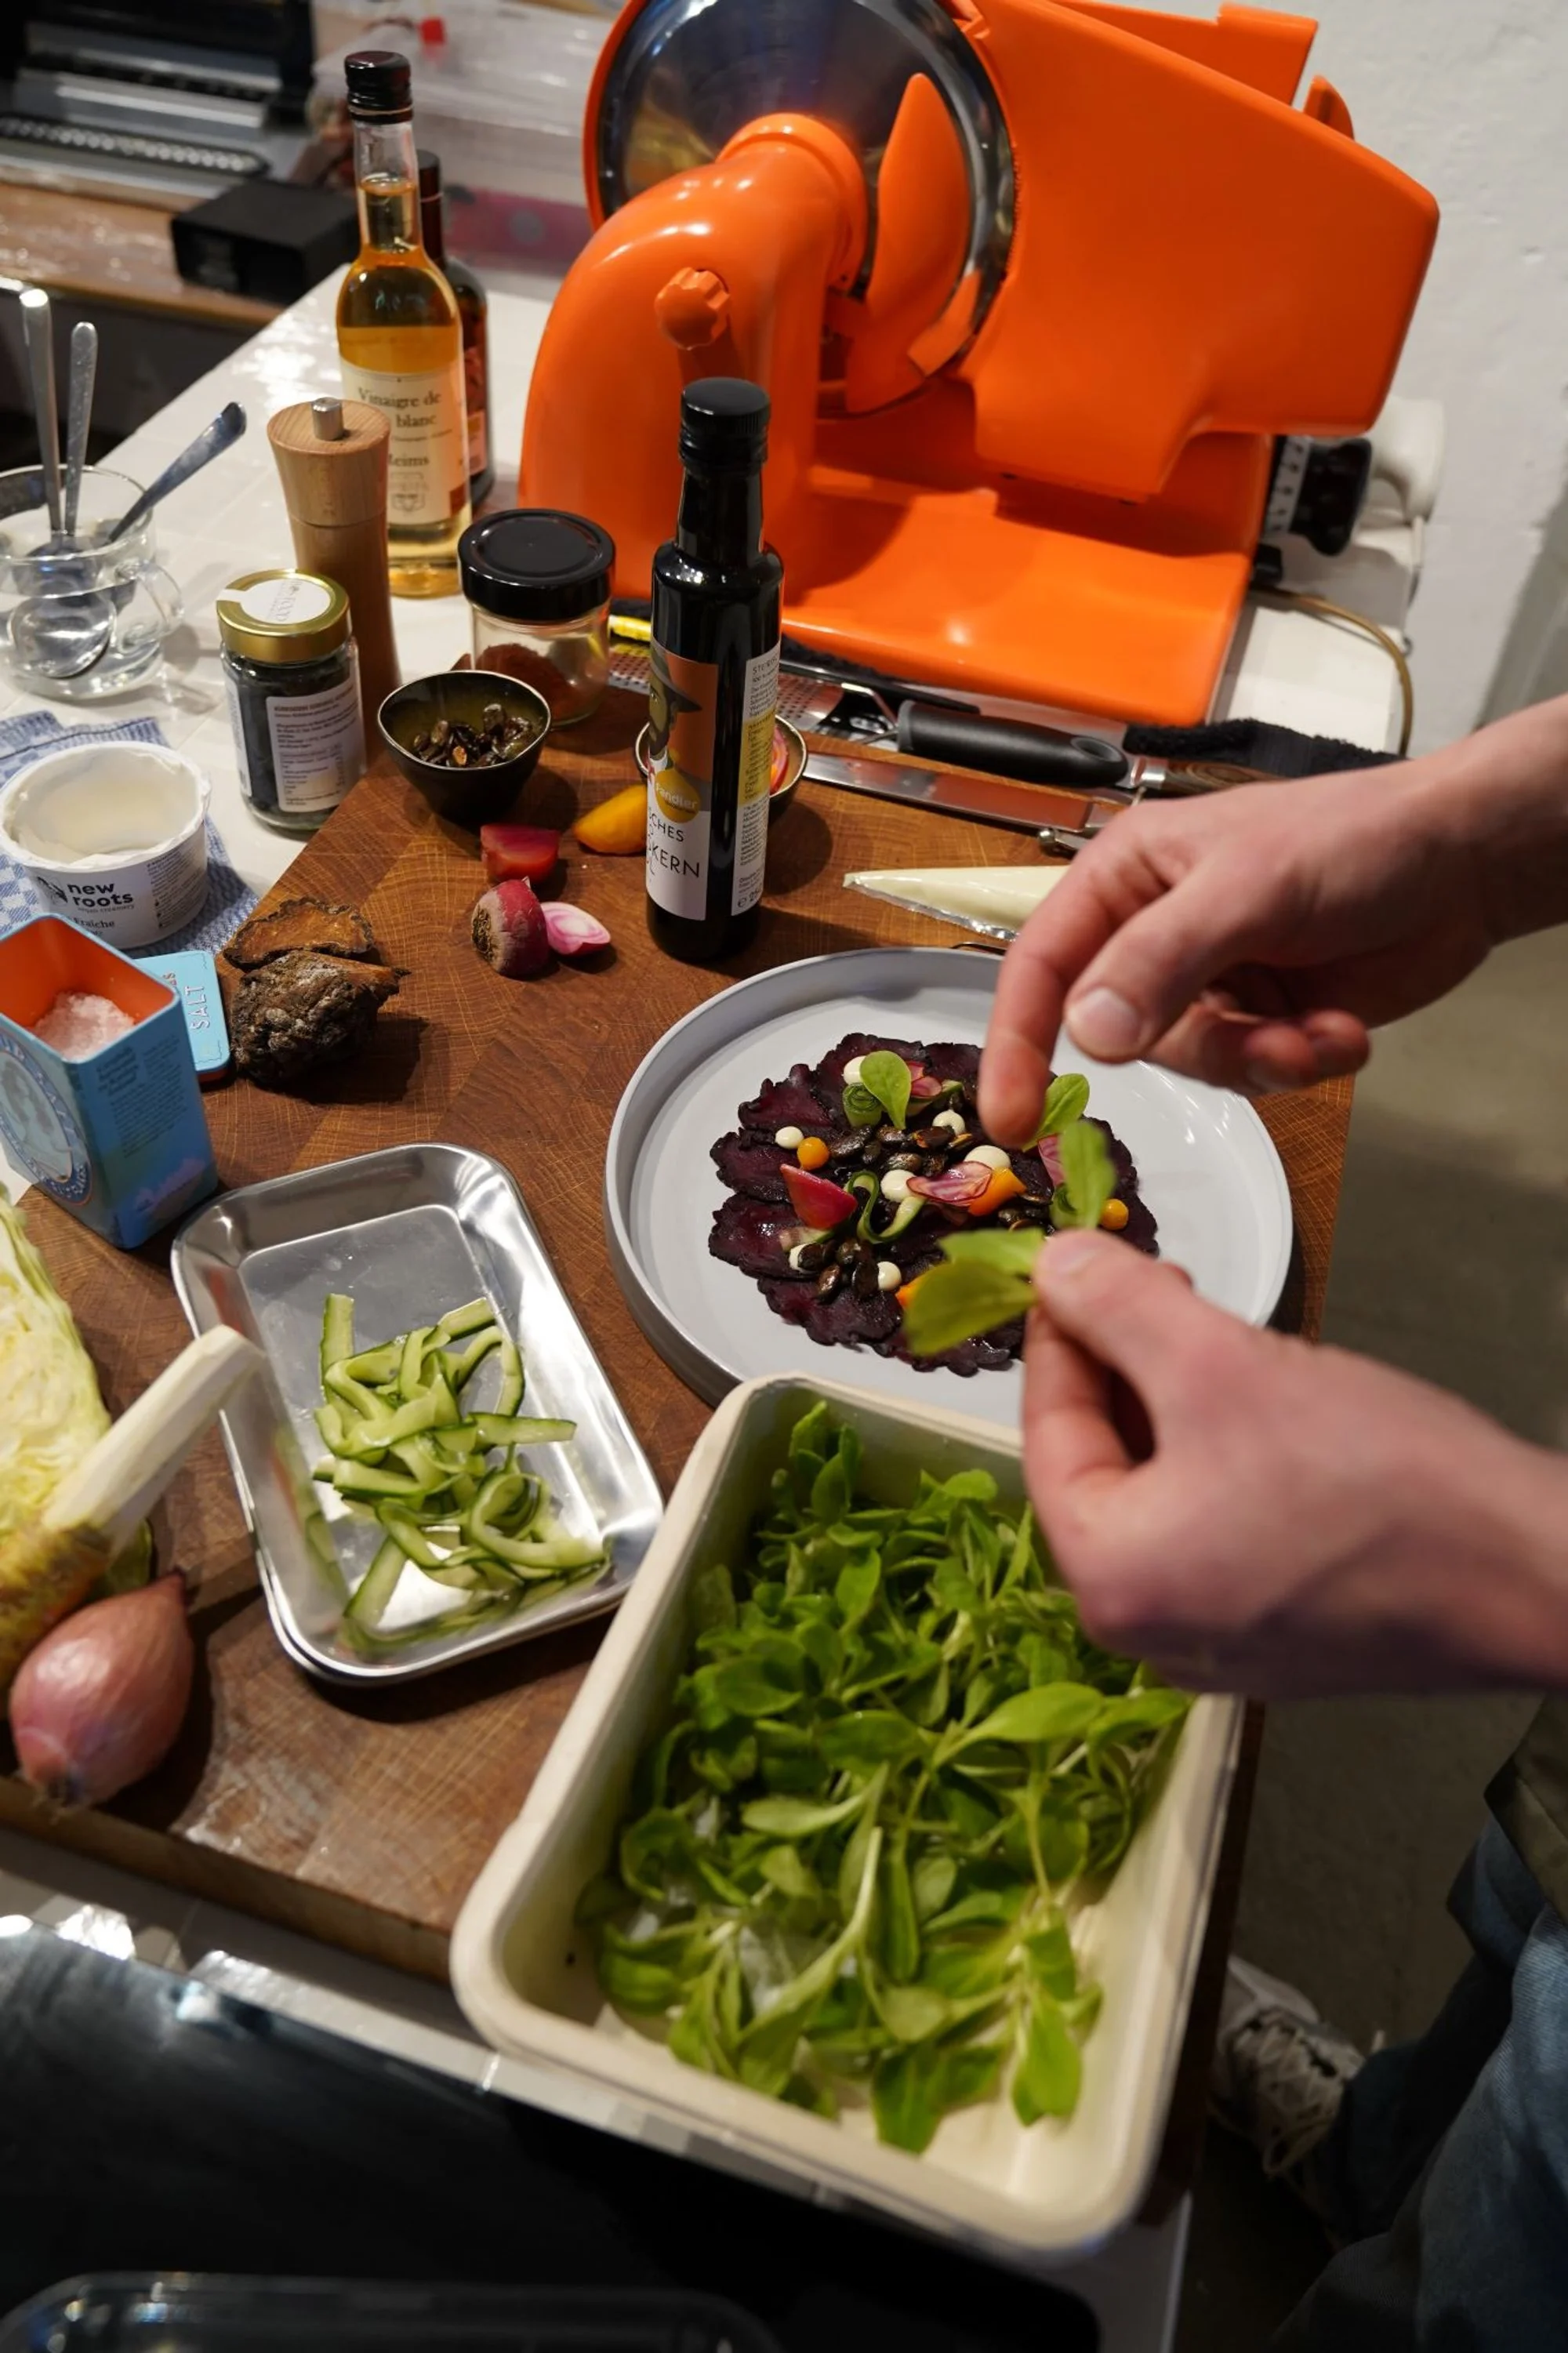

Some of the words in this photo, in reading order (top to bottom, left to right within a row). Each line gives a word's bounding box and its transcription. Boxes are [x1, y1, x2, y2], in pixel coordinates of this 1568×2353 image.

[358, 387, 419, 409] Vinaigre
[423, 390, 441, 405] de
[396, 414, 437, 428] blanc
[649, 812, 684, 843] CHES
[649, 842, 700, 878] KERN
[67, 883, 114, 895] new
[72, 892, 134, 908] roots
[184, 986, 211, 1029] SALT
